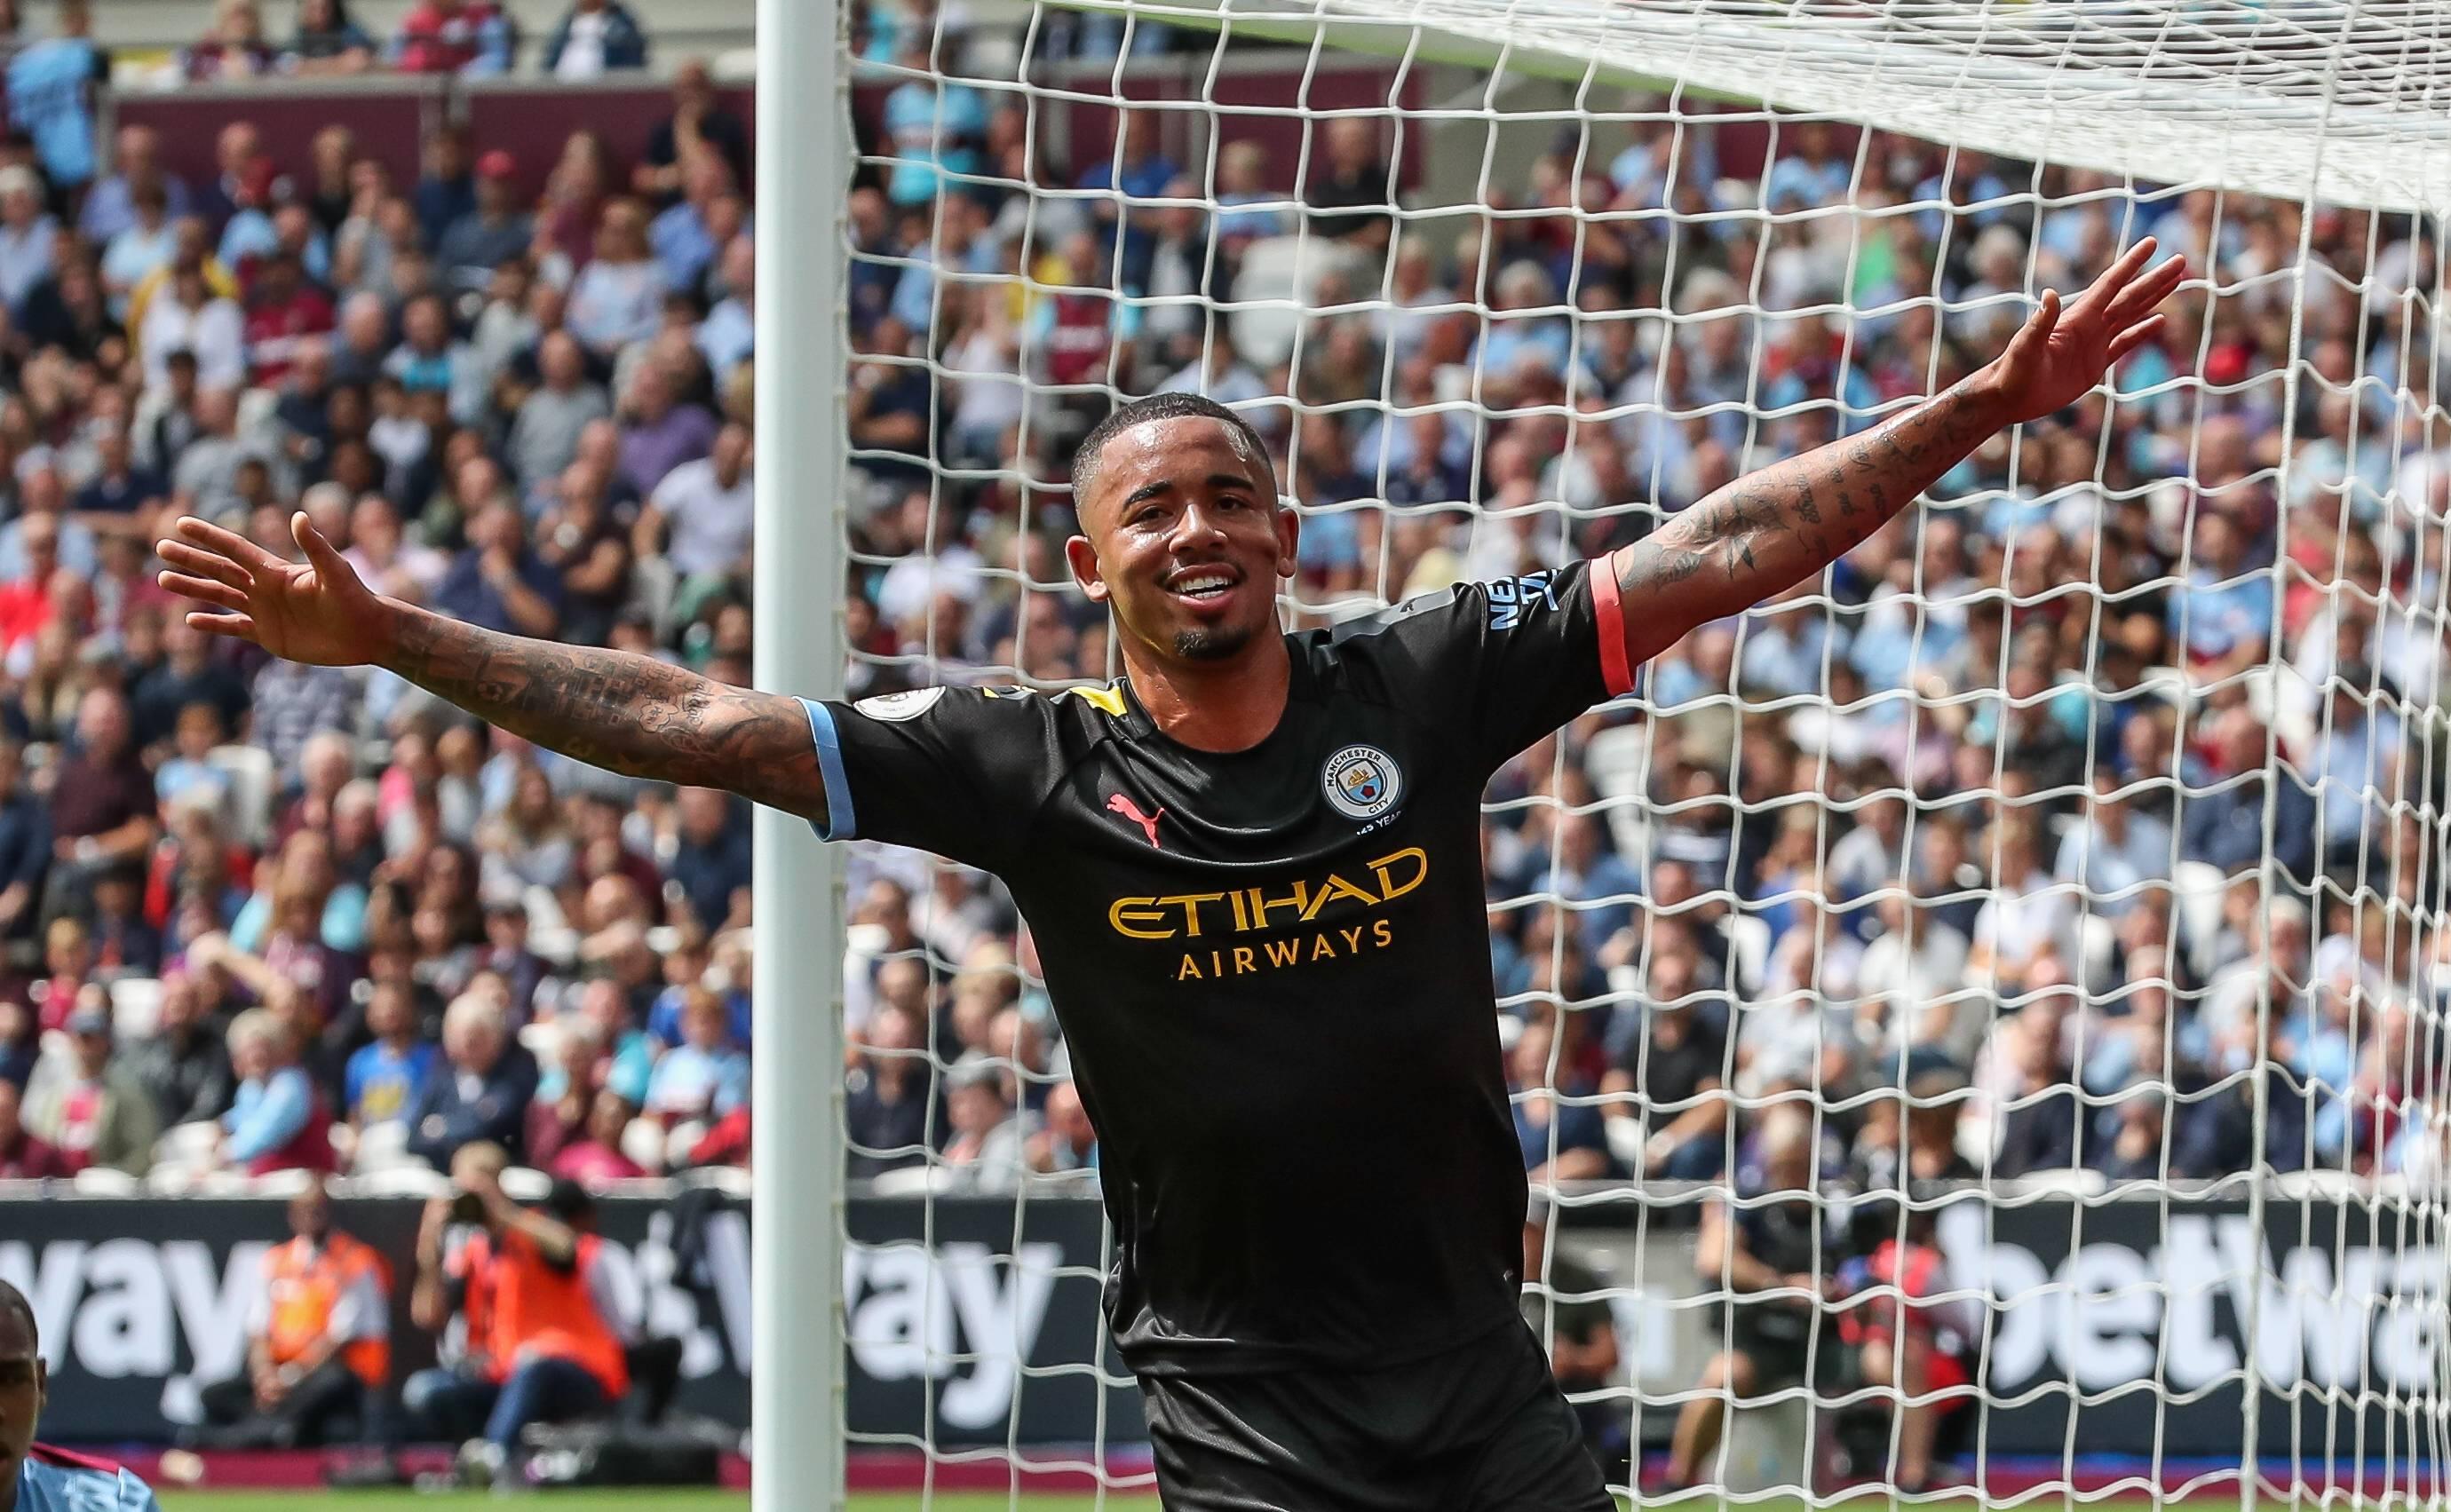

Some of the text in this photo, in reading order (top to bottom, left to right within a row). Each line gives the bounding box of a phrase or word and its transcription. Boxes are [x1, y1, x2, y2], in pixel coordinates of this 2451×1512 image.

[1327, 748, 1382, 788] MANCHESTER
[1368, 797, 1390, 814] CITY
[1108, 846, 1428, 939] ETIHAD
[1178, 919, 1392, 981] AIRWAYS
